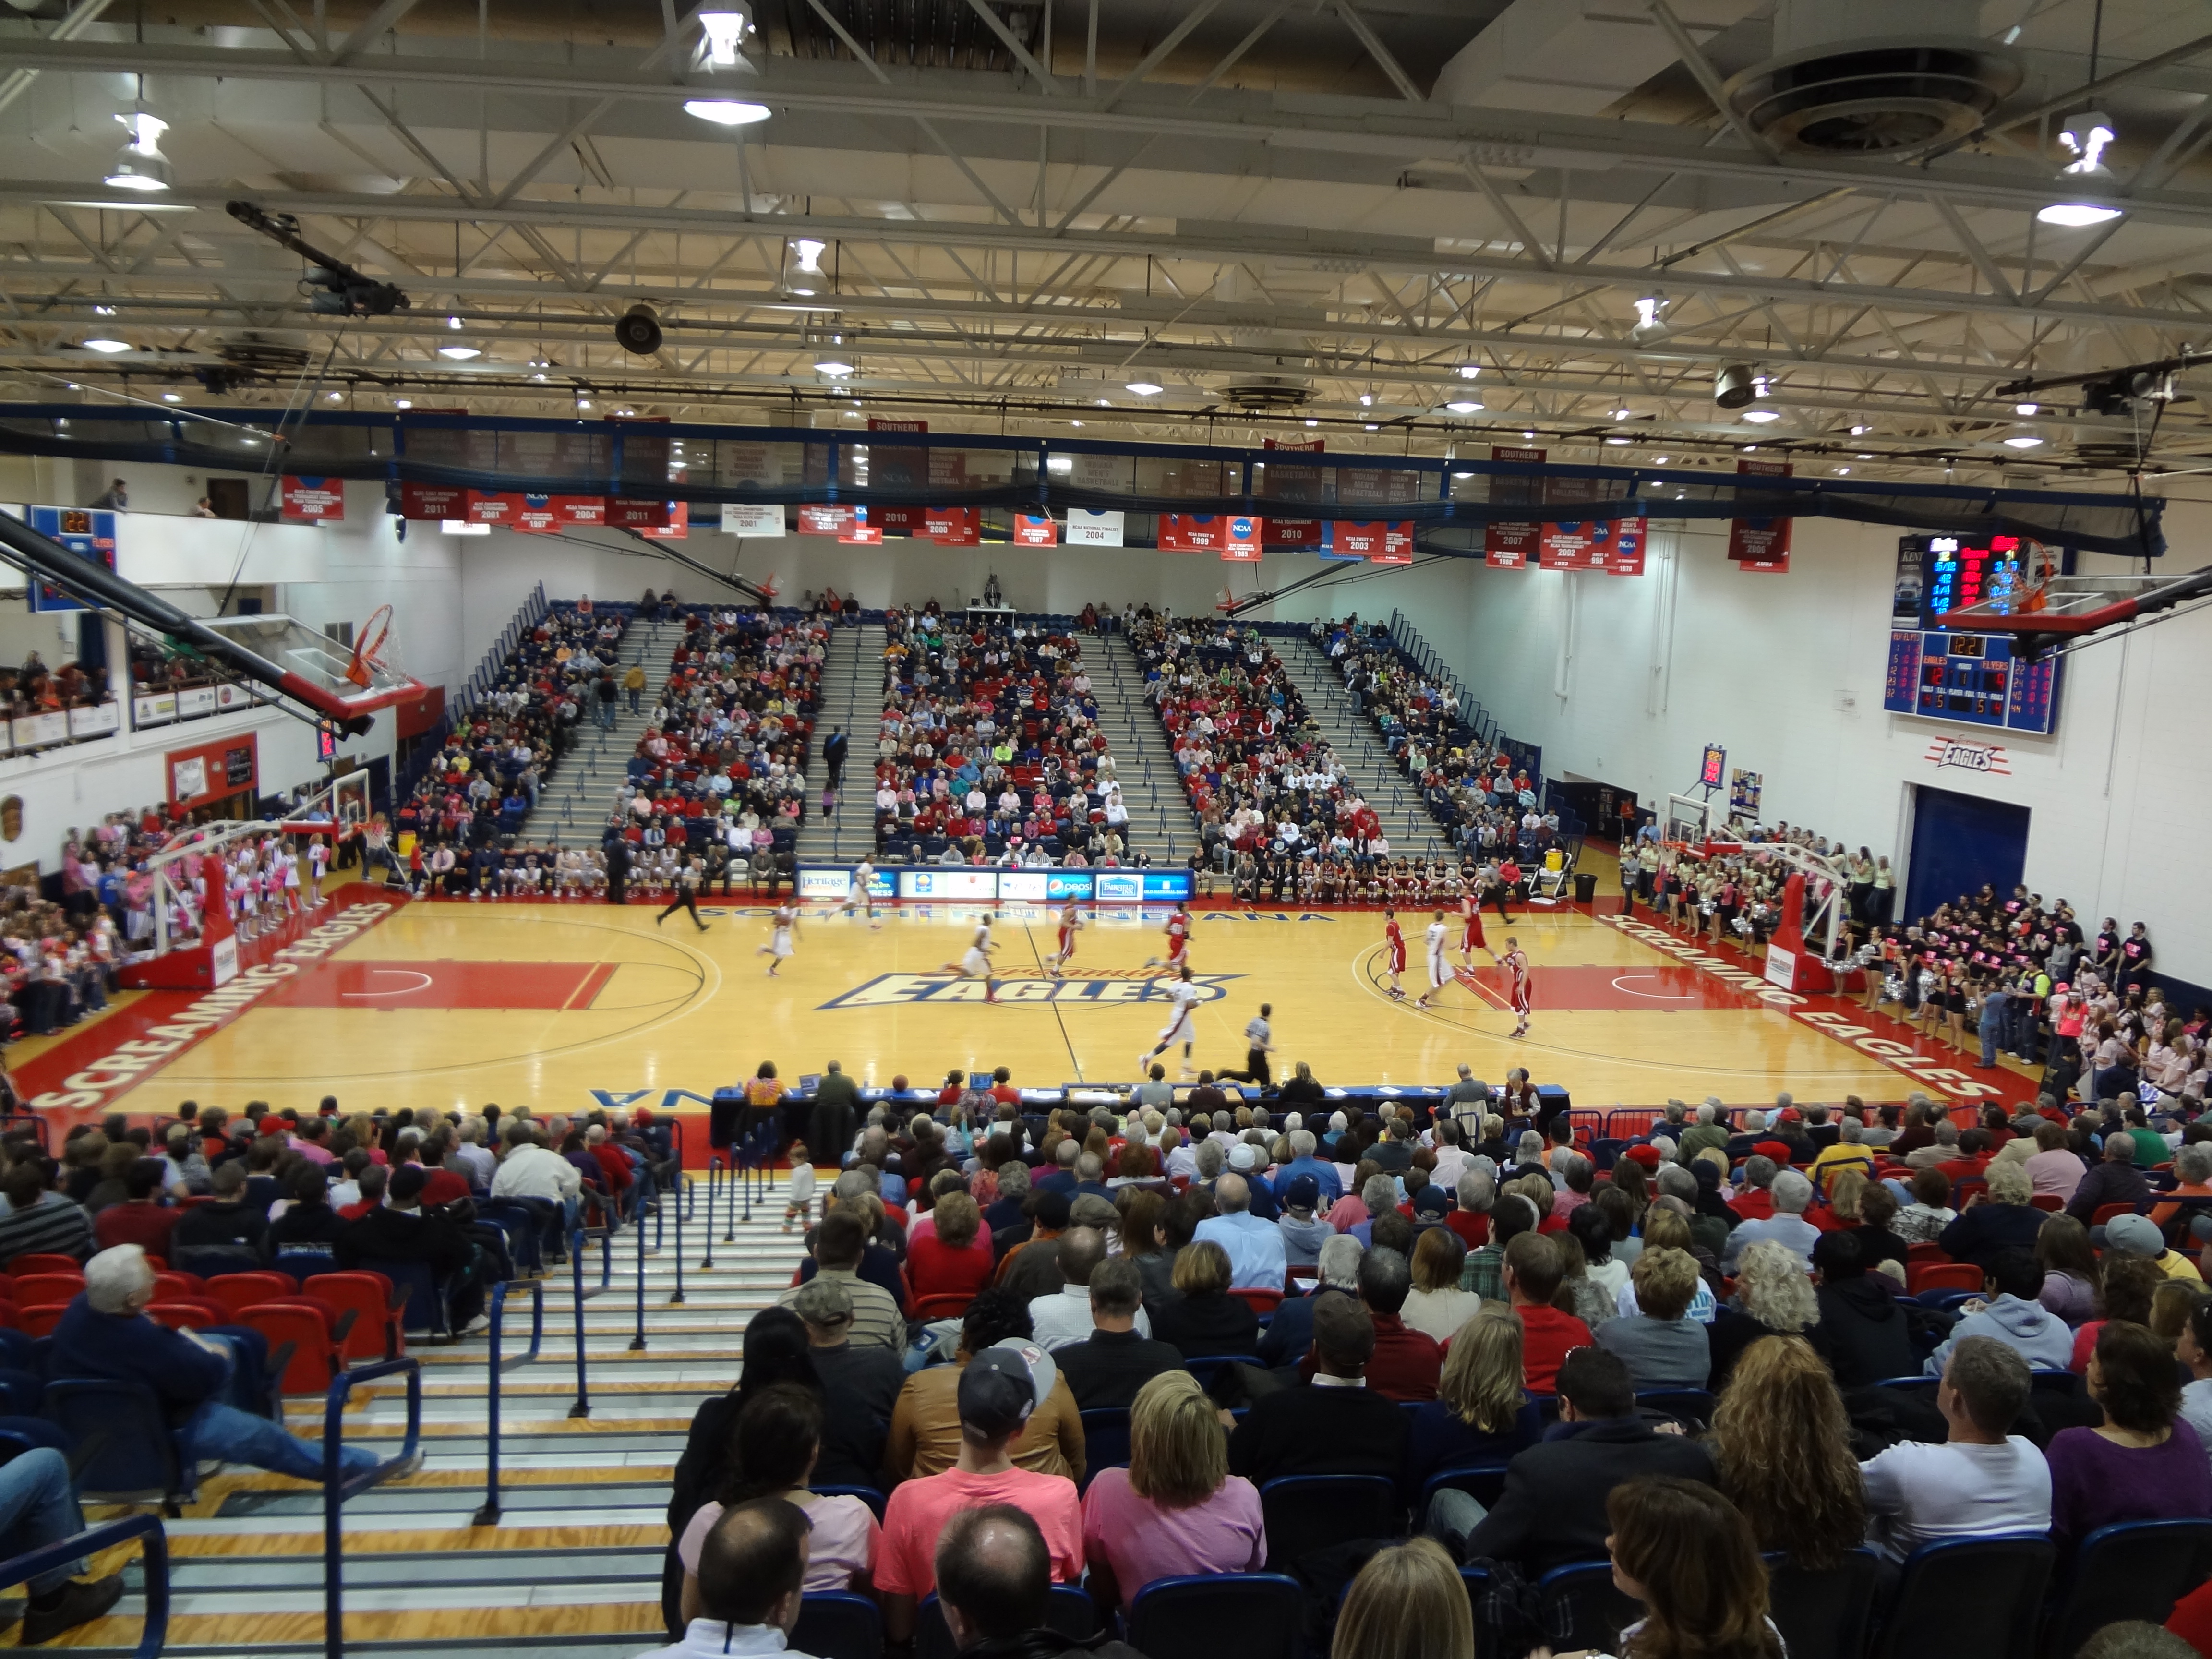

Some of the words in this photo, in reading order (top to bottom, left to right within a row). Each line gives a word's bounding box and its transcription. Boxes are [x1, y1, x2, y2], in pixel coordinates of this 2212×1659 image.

[877, 422, 919, 432] SOUTHERN
[1274, 443, 1315, 451] SOUTHERN
[1501, 450, 1538, 459] SOUTHERN
[1748, 462, 1784, 472] SOUTHERN
[1271, 470, 1317, 479] BASKETBALL
[1078, 477, 1118, 486] BASKETBALL
[1343, 489, 1383, 498] BASKETBALL
[302, 505, 323, 513] 2005
[425, 505, 446, 513] 2011
[626, 511, 648, 520] 2011
[885, 513, 907, 522] 2010
[1281, 530, 1302, 539] 2010
[1192, 537, 1209, 545] 1999
[1503, 536, 1523, 545] 2007
[1350, 542, 1369, 550] 2003
[1902, 552, 1923, 562] KENT
[1923, 655, 1948, 665] EAGLES
[1983, 660, 2008, 671] FLYERS
[2015, 665, 2025, 675] 22
[1931, 667, 1944, 685] 12
[2013, 678, 2023, 688] 24
[1937, 695, 1943, 708] 5
[1977, 700, 1984, 713] 5
[1938, 742, 1997, 772] EAGLES
[802, 876, 846, 890] Heritage
[1064, 881, 1092, 892] pepsi
[1104, 882, 1134, 891] FAIRFIELD
[814, 972, 1252, 1010] EAGLES
[31, 962, 300, 1109] SCREAMING
[272, 902, 392, 960] EAGLES
[1599, 914, 1808, 1005] SCREAMING
[1795, 1011, 2003, 1096] EAGLES
